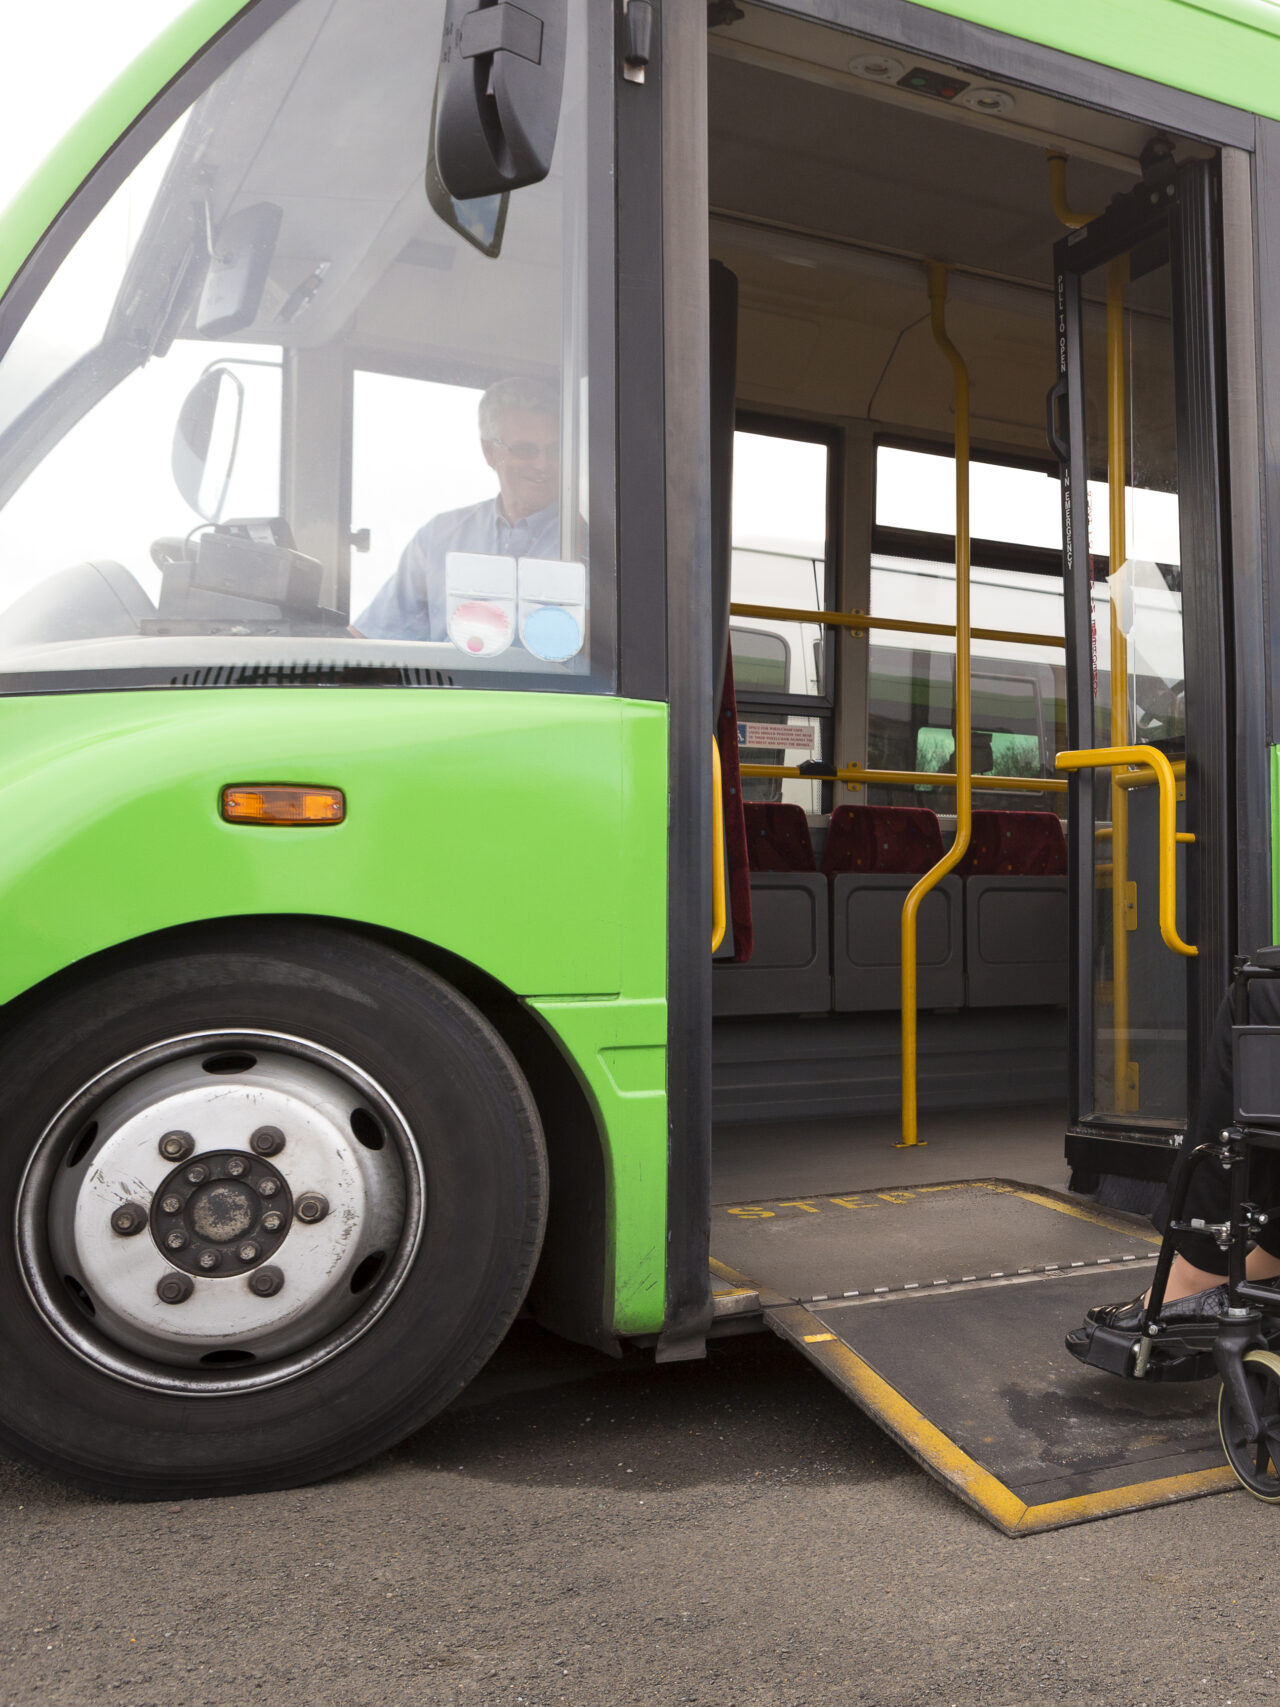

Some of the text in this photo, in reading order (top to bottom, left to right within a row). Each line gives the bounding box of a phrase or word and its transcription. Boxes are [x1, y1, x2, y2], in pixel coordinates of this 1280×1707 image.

[1059, 314, 1065, 333] TO
[1064, 468, 1070, 487] IN
[1064, 491, 1072, 570] EMERGENCY
[727, 1192, 916, 1219] STEP
